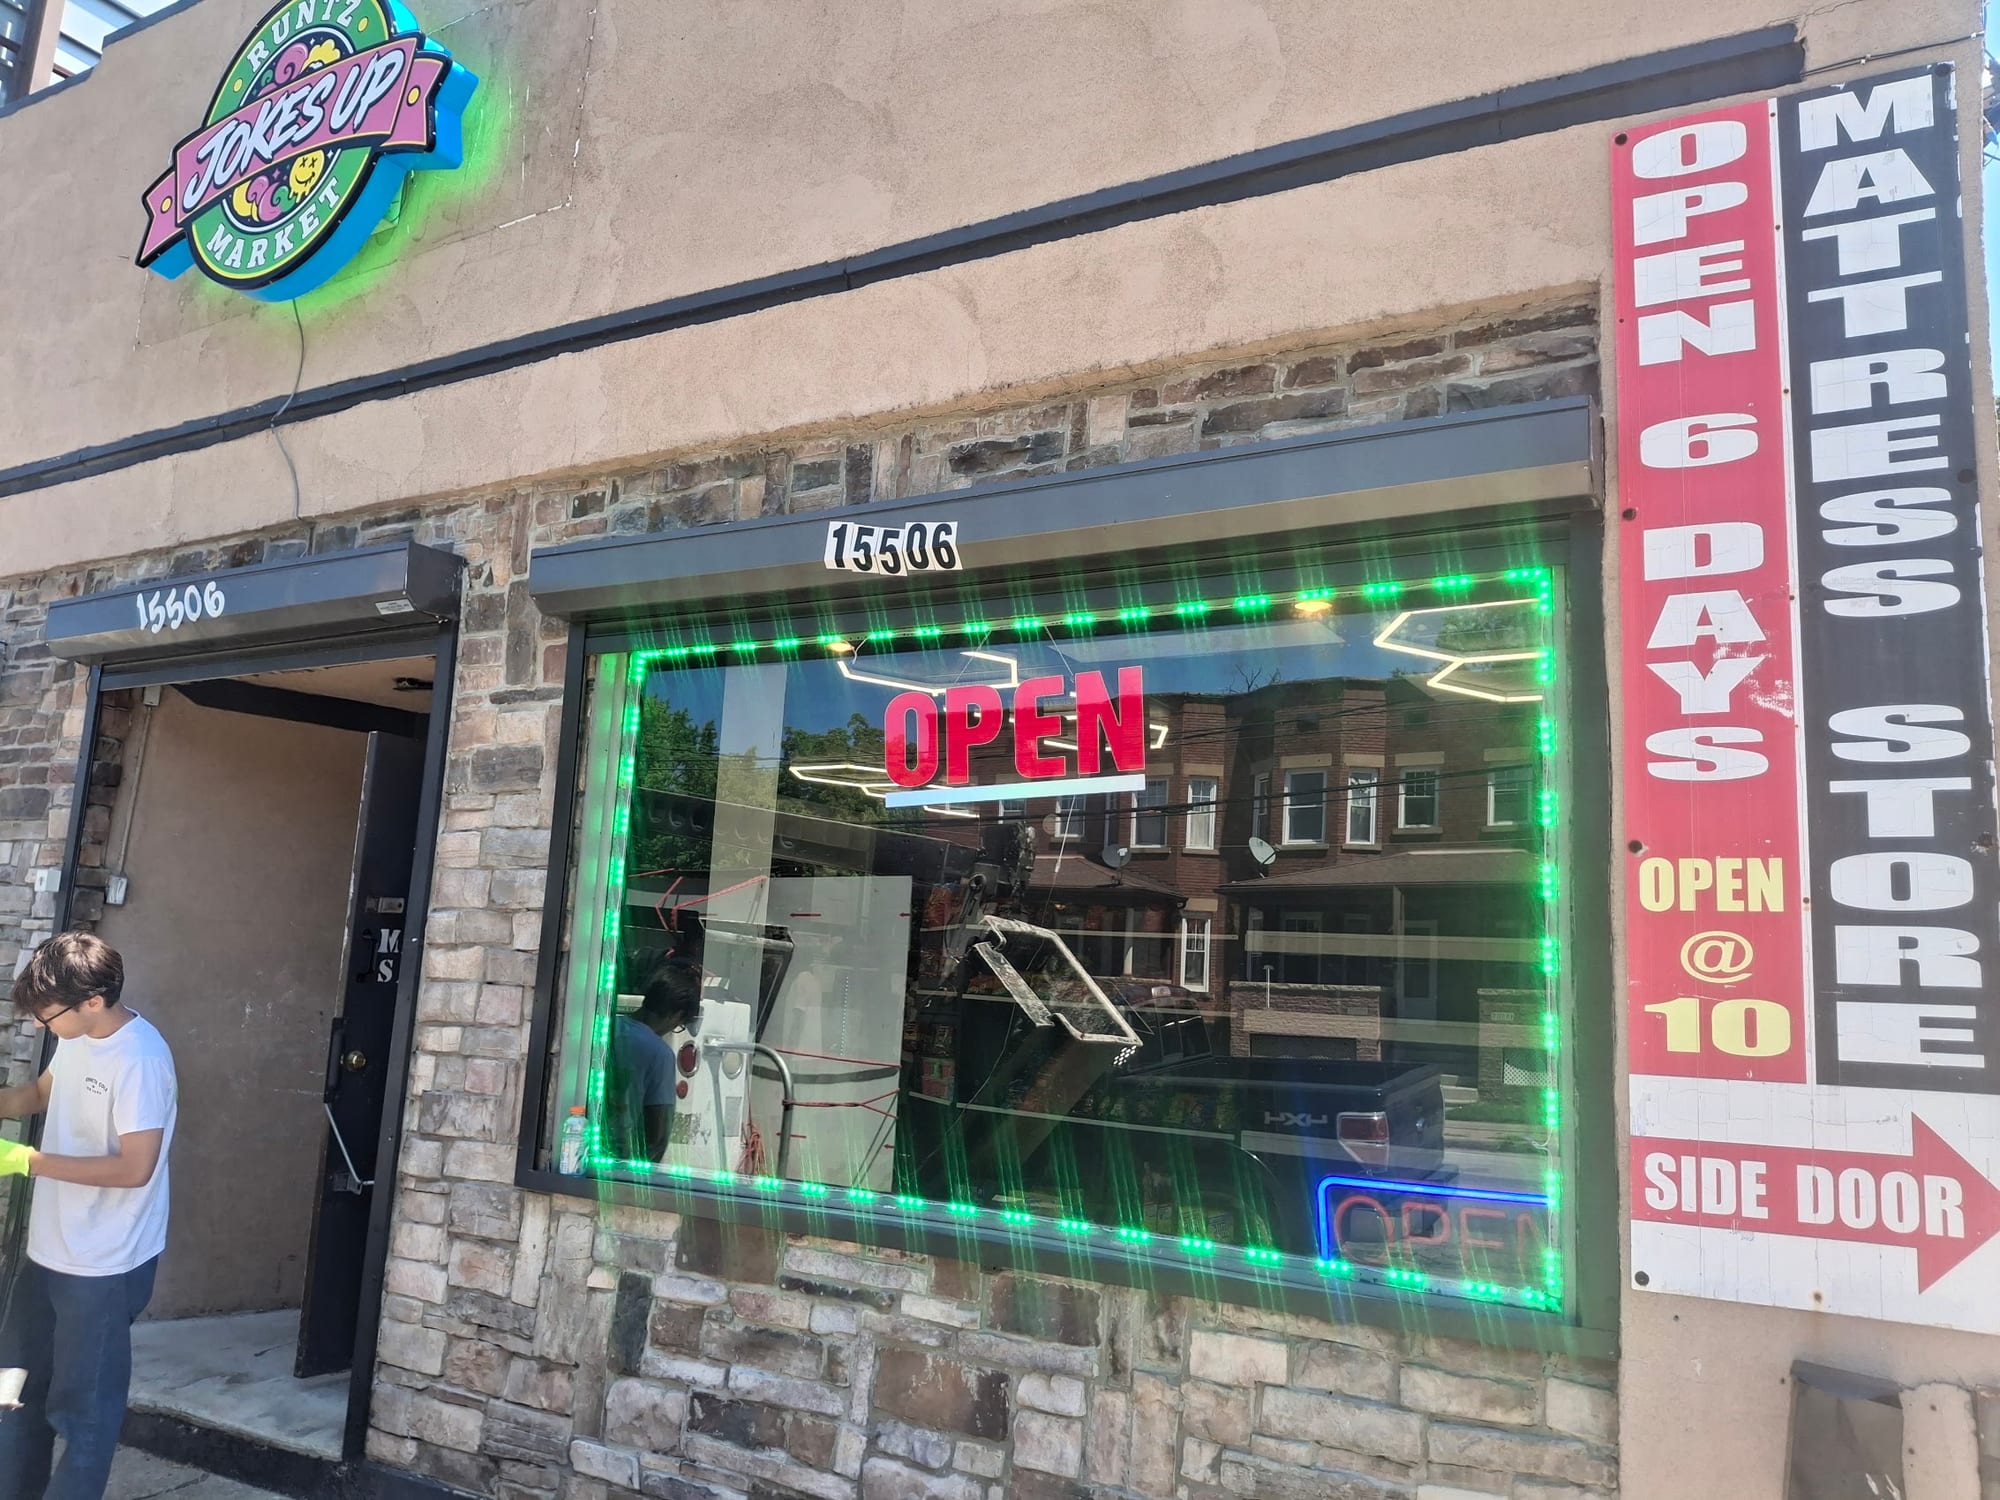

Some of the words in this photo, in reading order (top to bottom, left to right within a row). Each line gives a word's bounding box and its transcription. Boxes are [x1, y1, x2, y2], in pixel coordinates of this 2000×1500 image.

[247, 0, 361, 72] RUNTZ
[183, 72, 337, 209] JOKES
[330, 49, 404, 134] UP
[206, 177, 341, 269] MARKET
[1633, 120, 1756, 366] OPEN
[1799, 75, 1960, 617] MATTRESS
[1640, 413, 1758, 468] 6
[832, 523, 957, 575] 15506
[136, 581, 225, 634] 15506
[1643, 522, 1769, 781] DAYS
[884, 665, 1145, 787] OPEN
[1639, 856, 1784, 912] OPEN
[1829, 704, 1985, 1068] STORE
[1680, 930, 1753, 984] @
[1644, 997, 1791, 1057] 10
[1644, 1152, 1769, 1219] SIDE
[1796, 1164, 1965, 1238] DOOR
